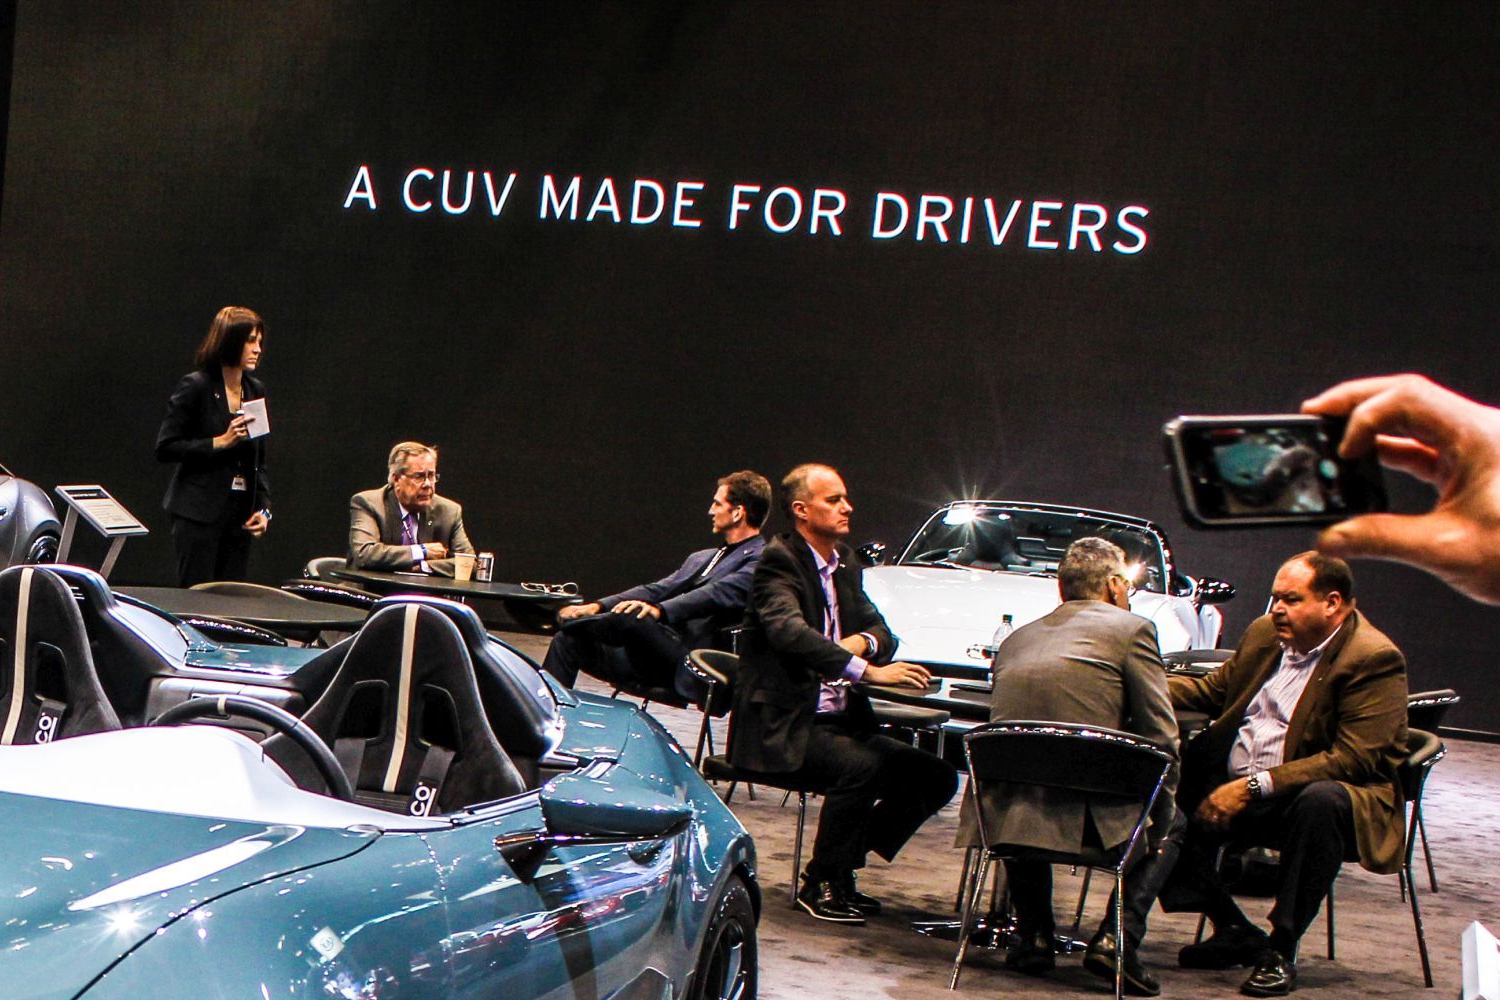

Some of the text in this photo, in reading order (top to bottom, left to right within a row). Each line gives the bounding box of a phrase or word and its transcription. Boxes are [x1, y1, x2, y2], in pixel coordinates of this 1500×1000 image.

[343, 165, 1150, 254] A CUV MADE FOR DRIVERS
